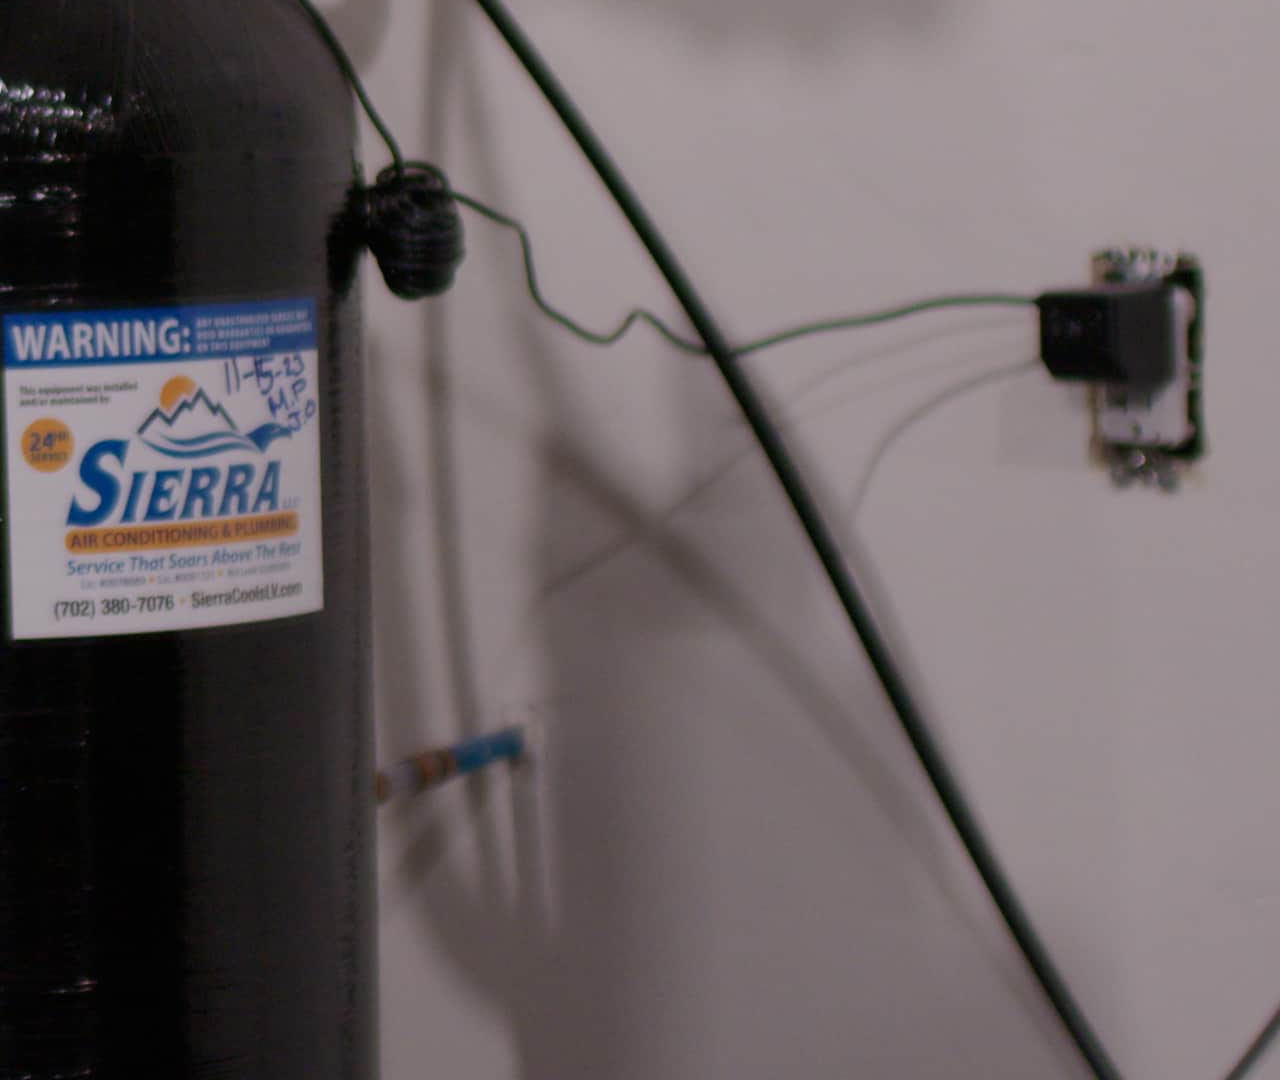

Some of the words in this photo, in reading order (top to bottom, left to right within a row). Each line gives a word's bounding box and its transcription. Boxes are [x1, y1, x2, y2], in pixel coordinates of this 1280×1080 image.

[12, 318, 190, 360] WARNING:
[66, 439, 282, 527] SIERRA
[70, 532, 99, 549] AIR
[103, 522, 220, 546] CONDITIONING
[66, 557, 125, 577] Service
[130, 555, 165, 571] That
[168, 551, 209, 568] Soars
[212, 546, 253, 565] Above
[256, 544, 278, 559] The
[53, 598, 96, 620] (702)
[101, 595, 175, 615] 380-7076
